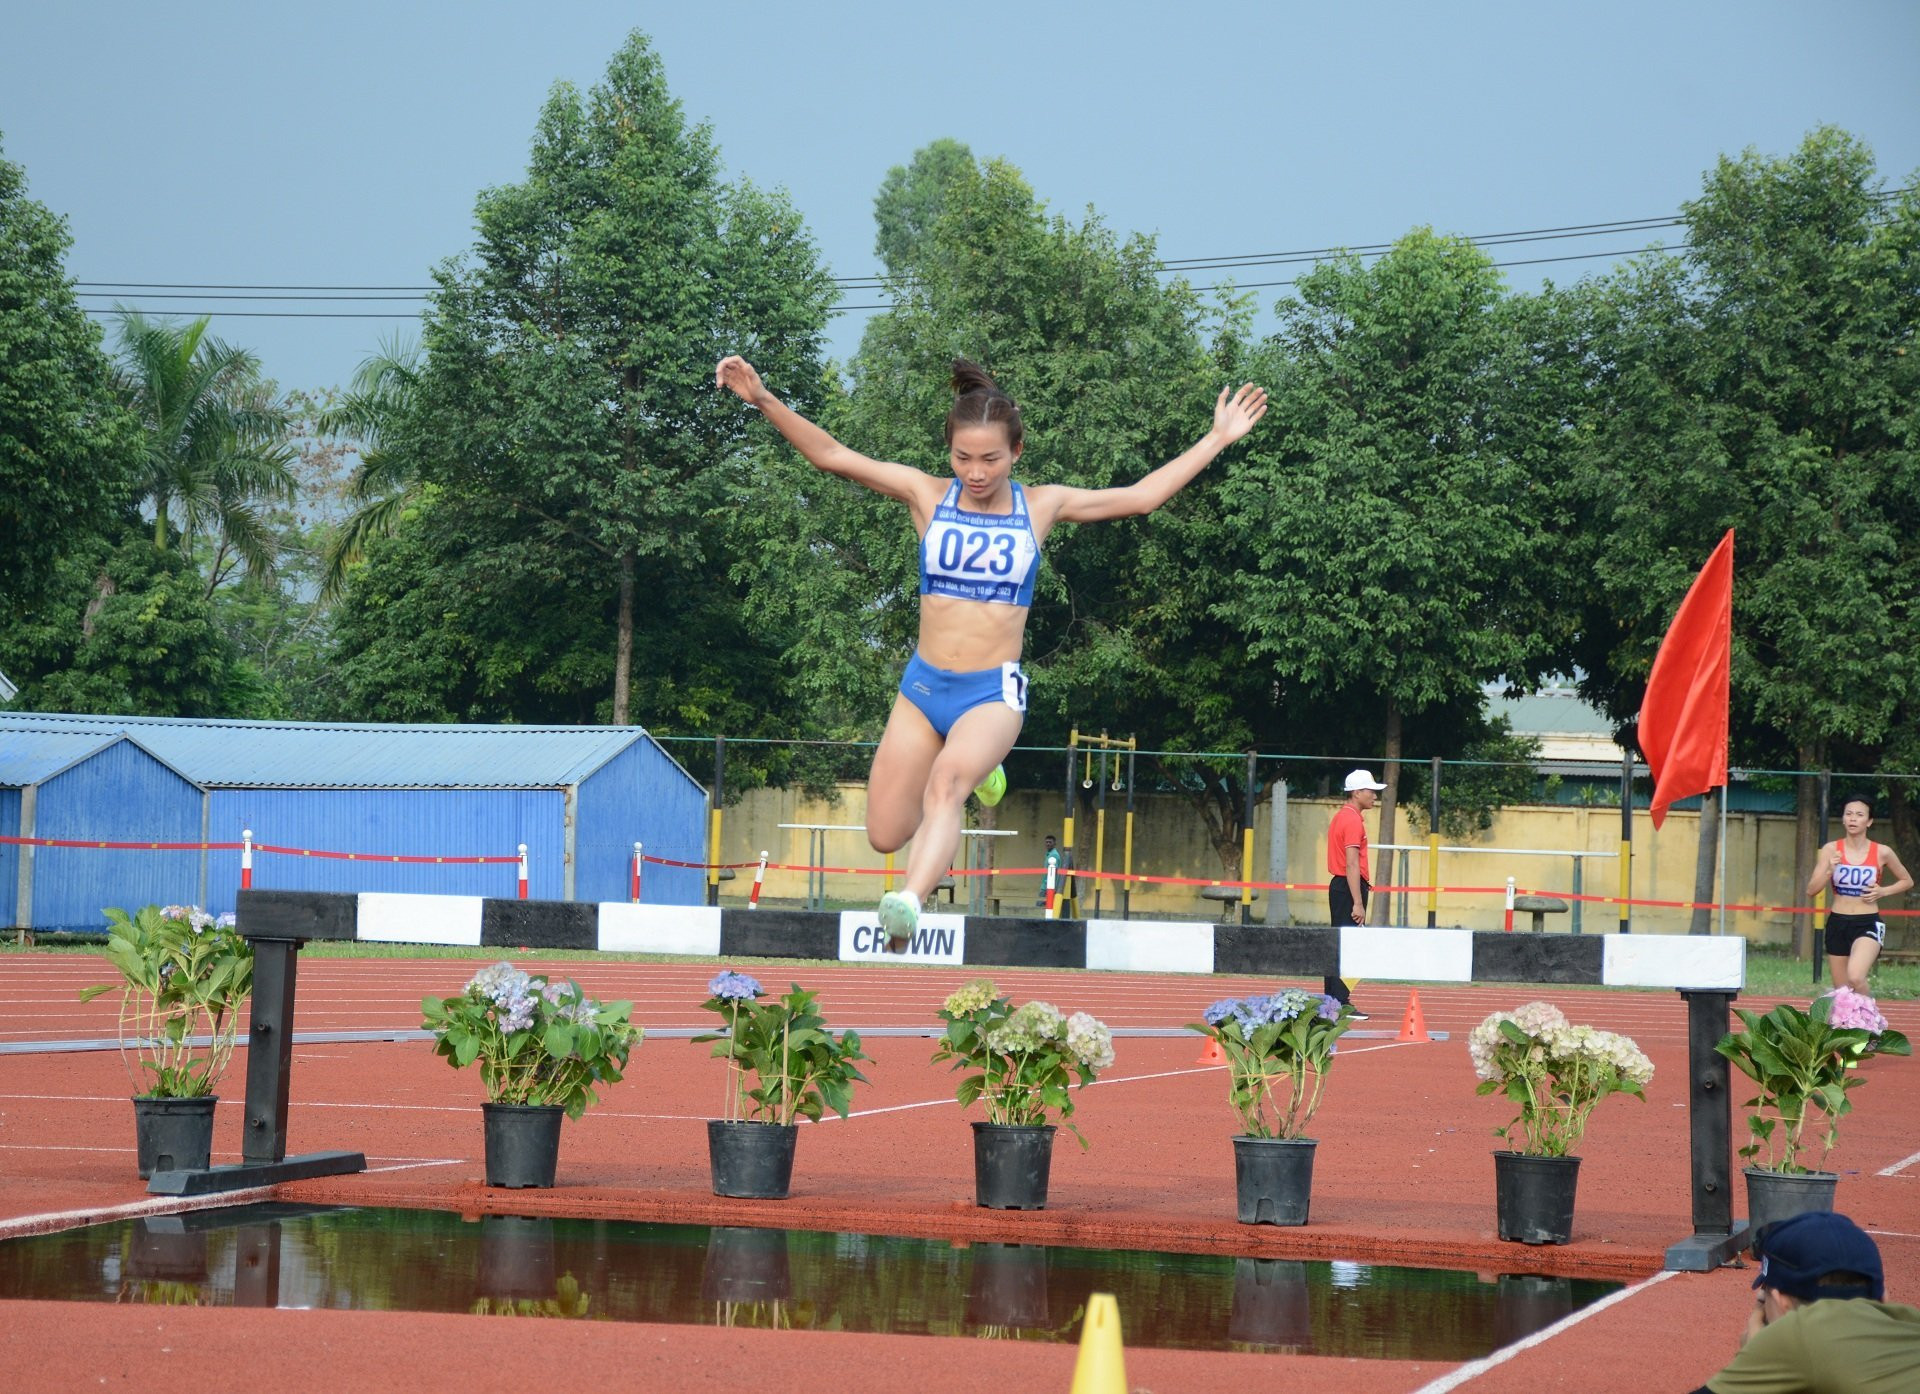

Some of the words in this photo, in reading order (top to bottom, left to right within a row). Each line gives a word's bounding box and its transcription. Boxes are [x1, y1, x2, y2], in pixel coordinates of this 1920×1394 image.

[938, 528, 1016, 576] 023
[1839, 867, 1873, 887] 202
[852, 926, 956, 955] CRWN
